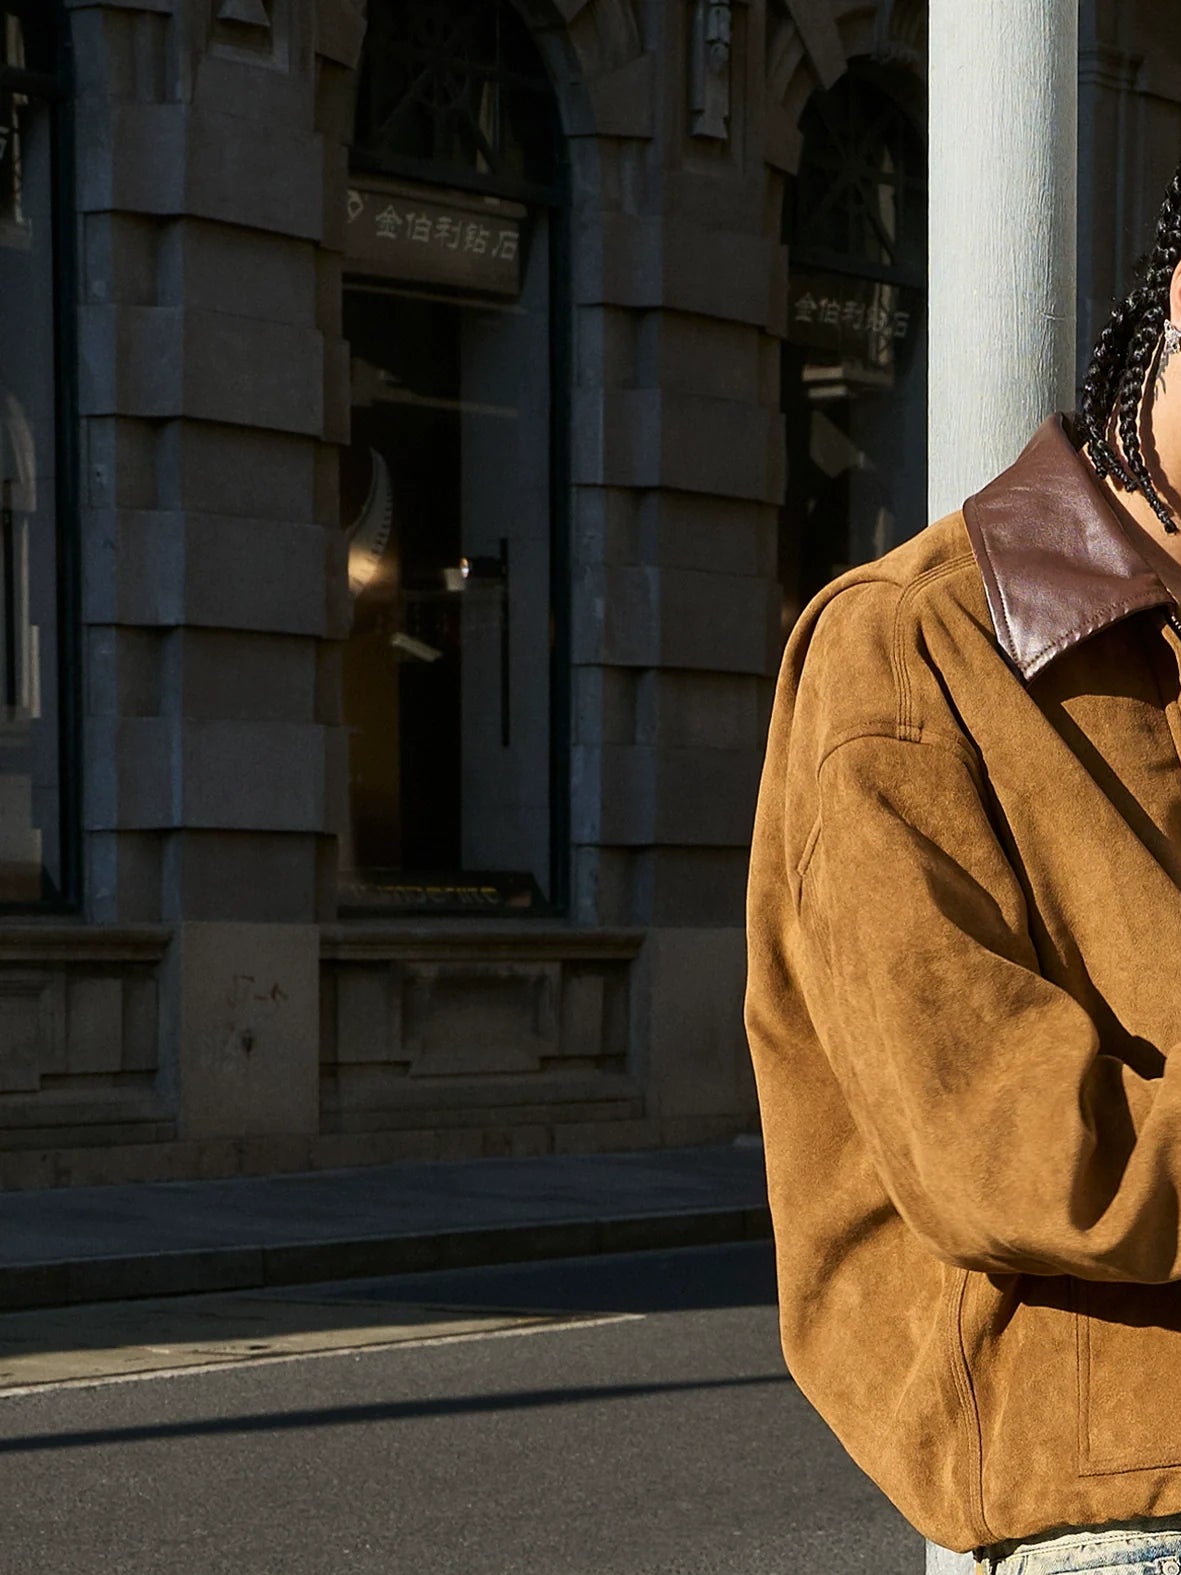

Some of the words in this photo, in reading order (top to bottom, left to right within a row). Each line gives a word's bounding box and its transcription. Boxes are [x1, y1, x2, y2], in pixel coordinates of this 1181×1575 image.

[375, 204, 520, 260] 金伯利钻石
